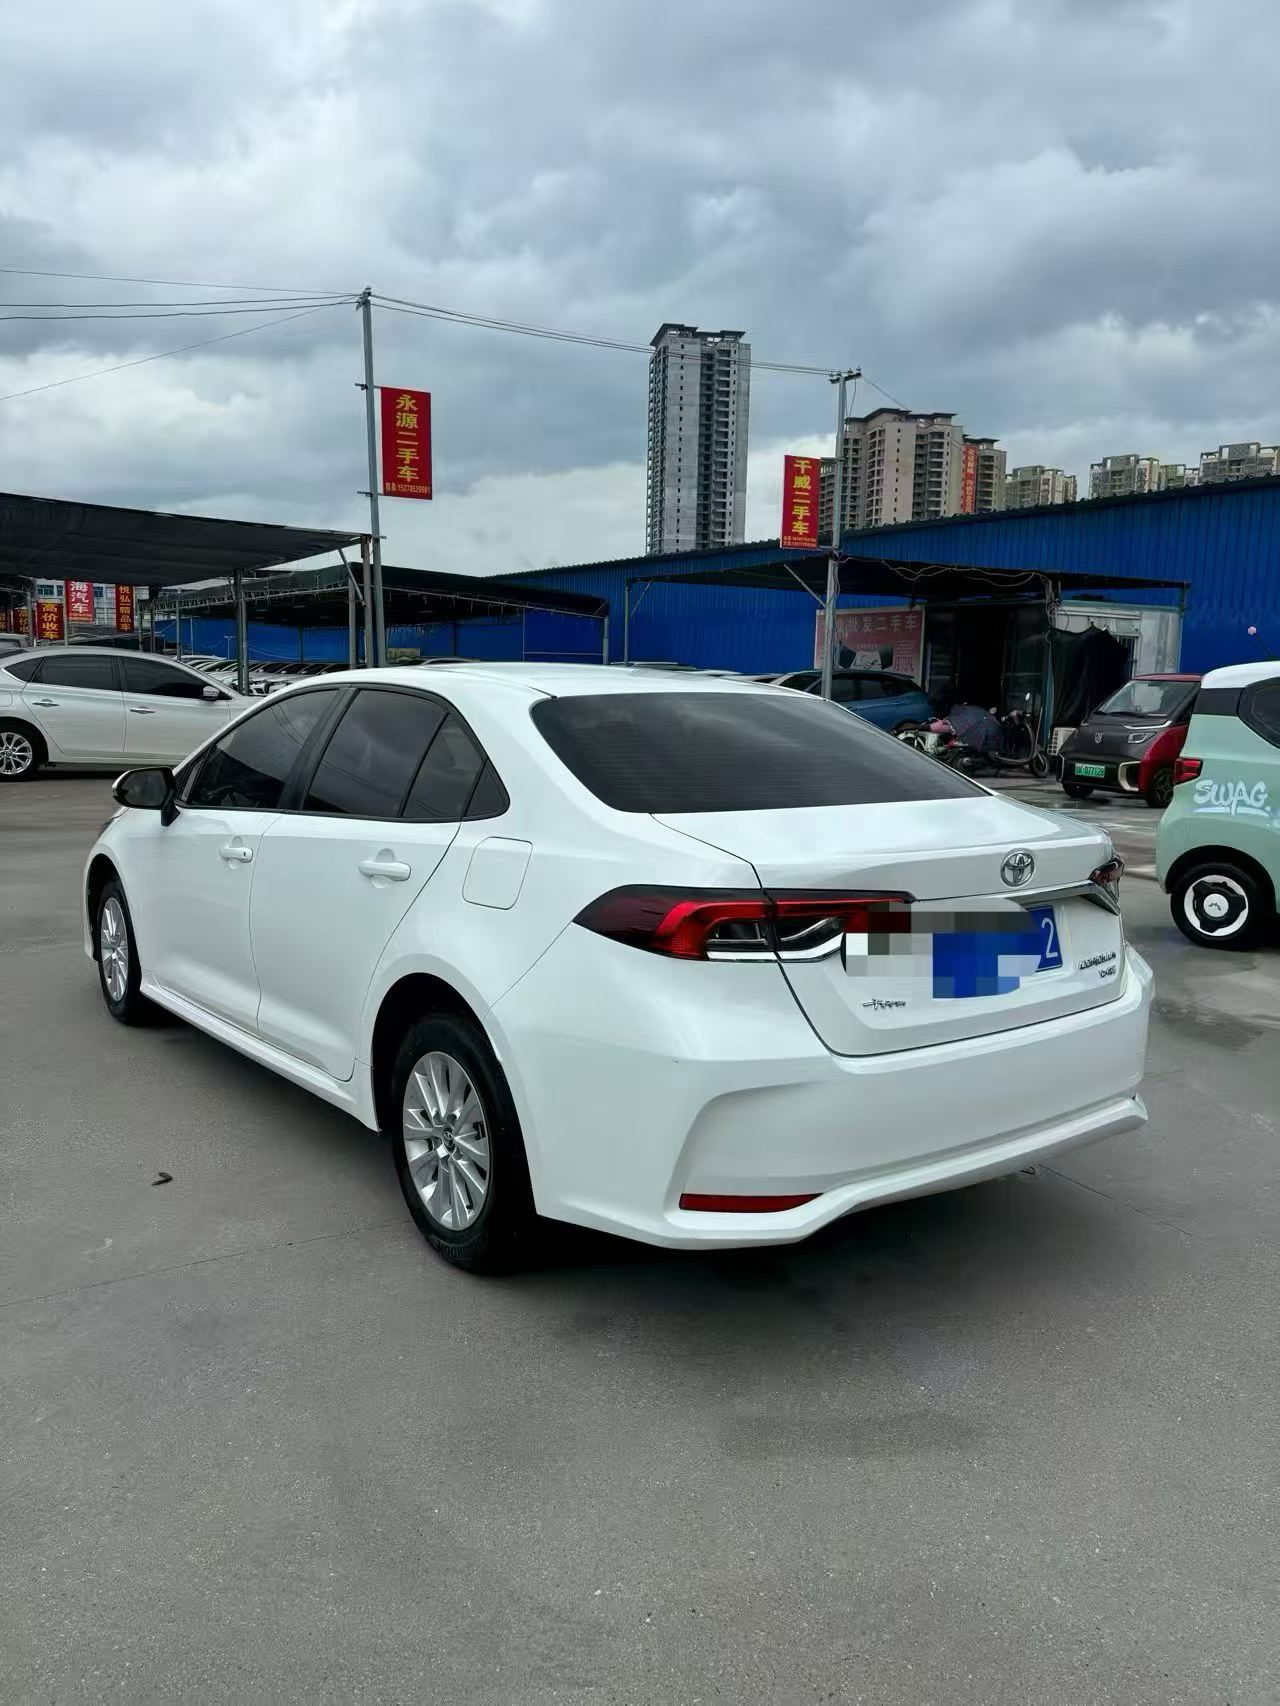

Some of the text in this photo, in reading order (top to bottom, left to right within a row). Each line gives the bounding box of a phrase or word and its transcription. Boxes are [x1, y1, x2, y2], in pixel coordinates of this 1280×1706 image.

[396, 393, 419, 481] 永源二手车
[42, 602, 60, 640] 高价收车
